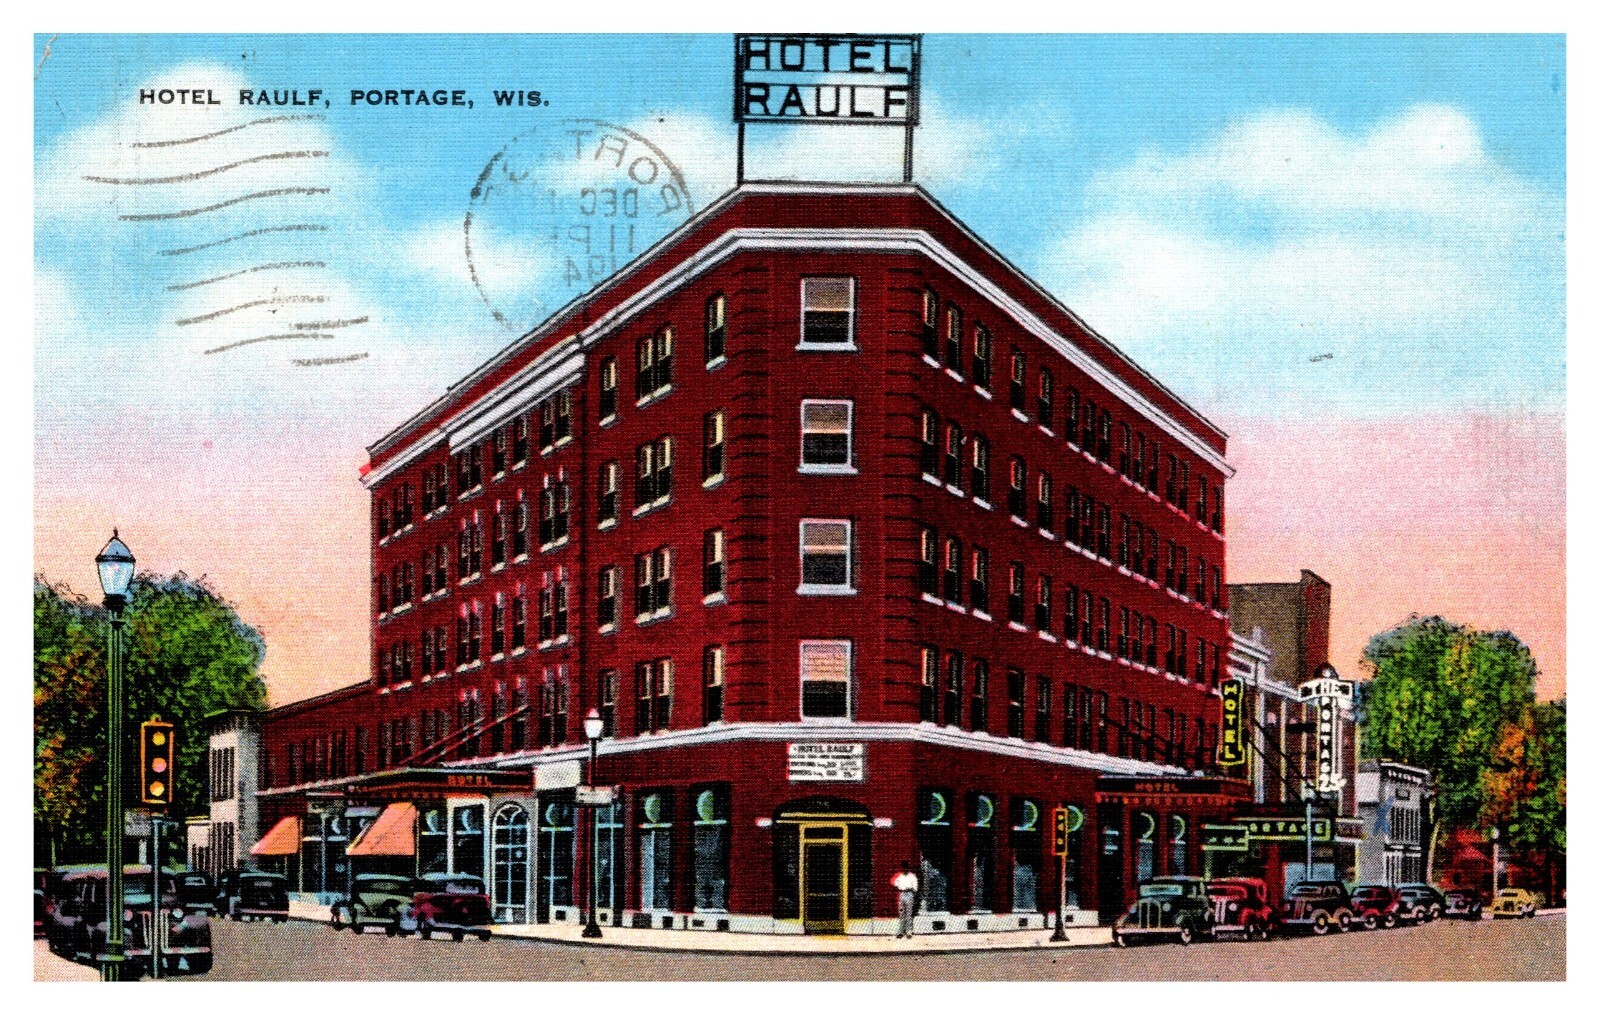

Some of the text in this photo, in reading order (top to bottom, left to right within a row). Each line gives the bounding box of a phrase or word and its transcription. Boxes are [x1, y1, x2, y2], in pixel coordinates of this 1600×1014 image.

[744, 39, 908, 73] HOTEL
[744, 83, 909, 117] RAULF
[1224, 683, 1238, 759] HOTEL
[447, 775, 492, 787] HOTEL
[1135, 783, 1179, 792] HOTEL
